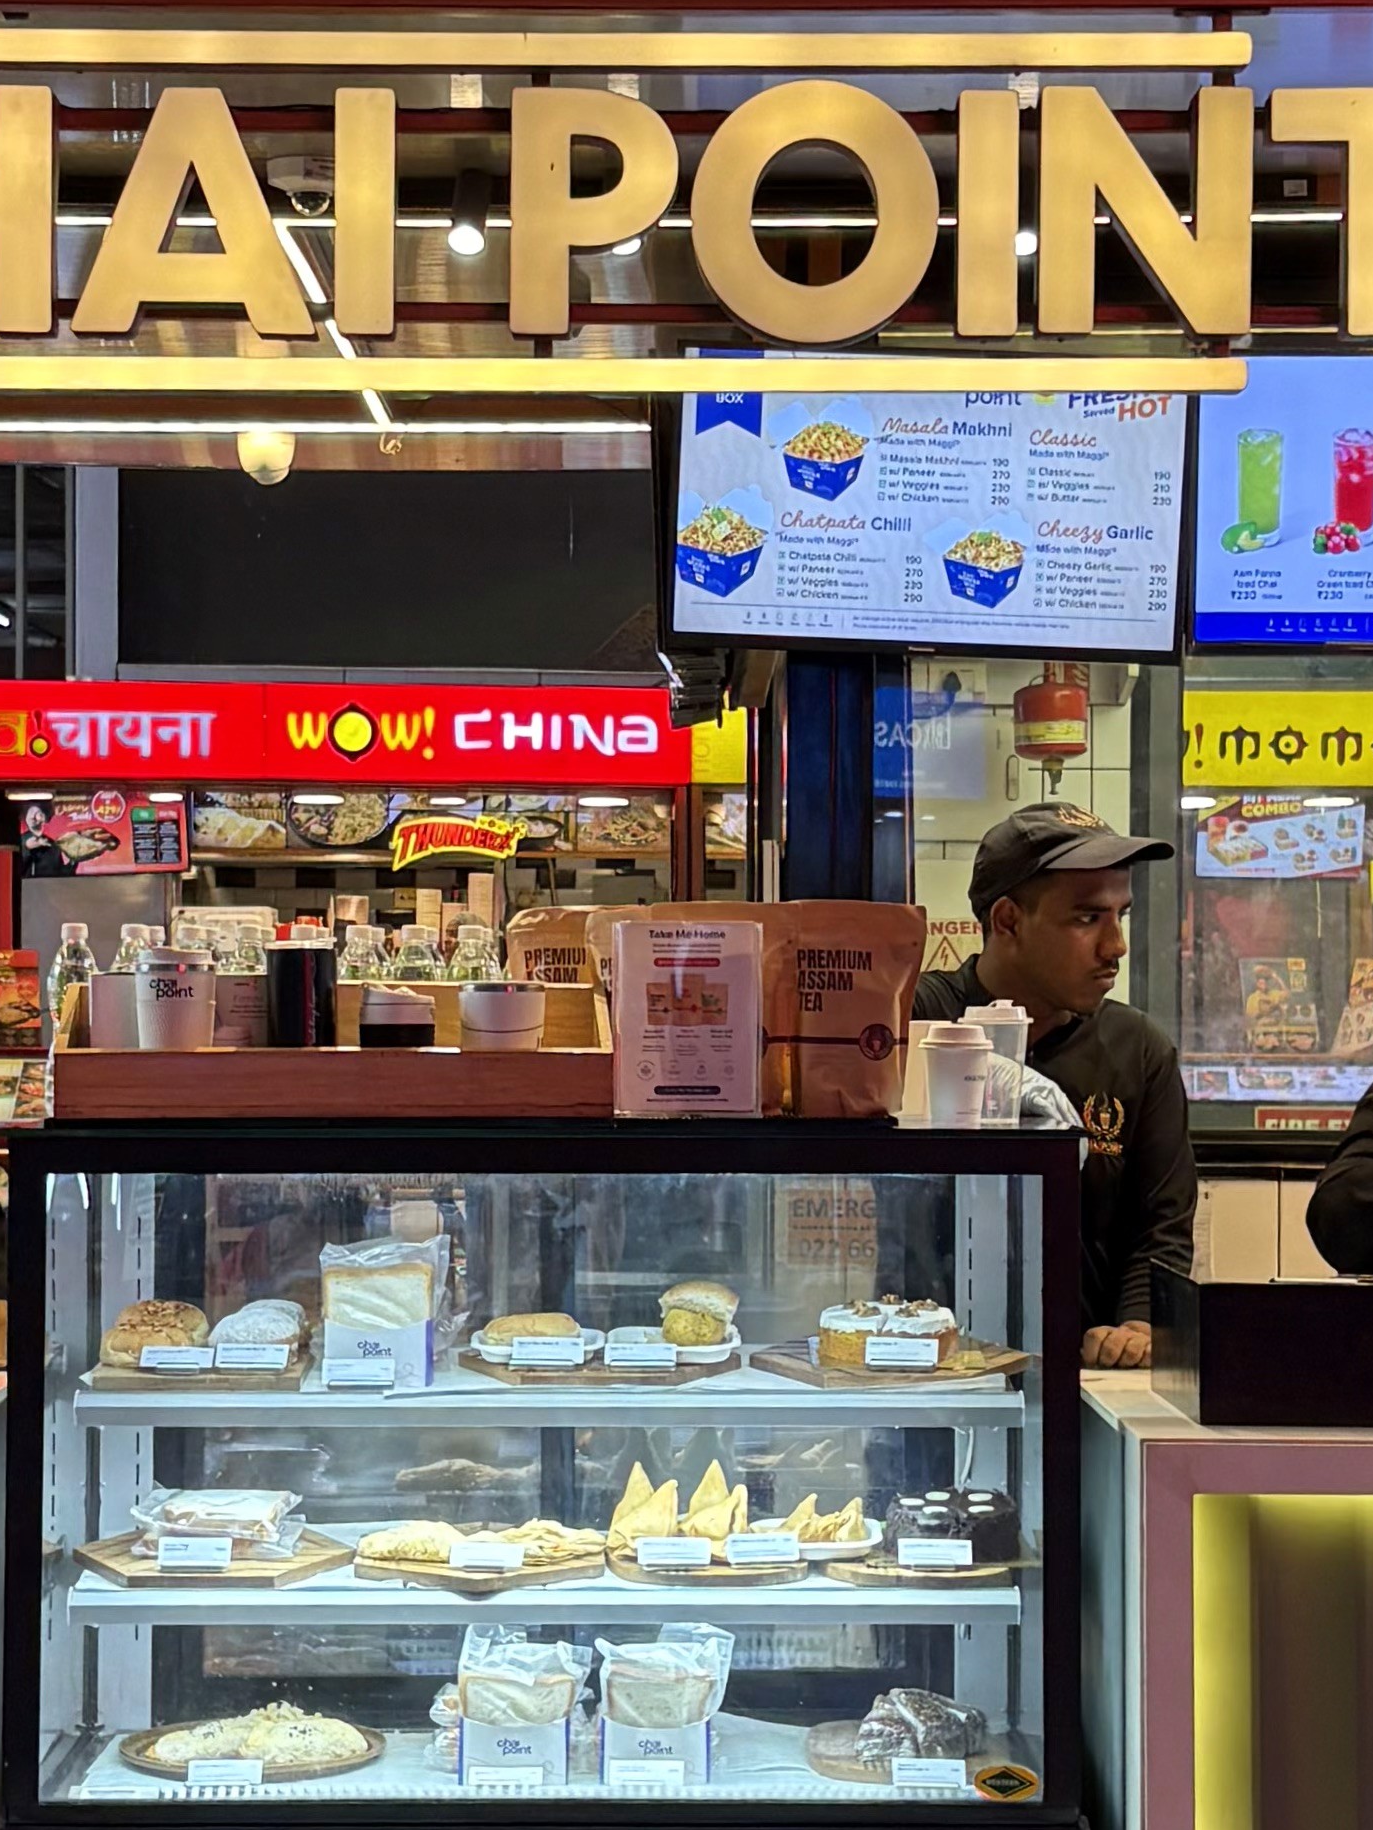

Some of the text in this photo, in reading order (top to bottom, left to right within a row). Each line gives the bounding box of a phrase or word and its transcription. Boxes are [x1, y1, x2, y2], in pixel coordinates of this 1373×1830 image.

[1083, 396, 1172, 422] Served HOT
[882, 417, 1013, 437] Masala Makhni
[1029, 428, 1097, 448] Classic
[992, 471, 1011, 480] 270
[781, 509, 912, 533] Chatpata Chilli
[1037, 519, 1154, 545] Cheezy Garlic
[905, 568, 923, 578] 270
[1148, 577, 1167, 587] 270
[1241, 802, 1302, 818] COMBO
[796, 948, 873, 971] PREMIUM
[149, 976, 180, 991] chai
[796, 971, 854, 992] ASSAM
[156, 983, 195, 1001] point
[797, 991, 824, 1013] TEA
